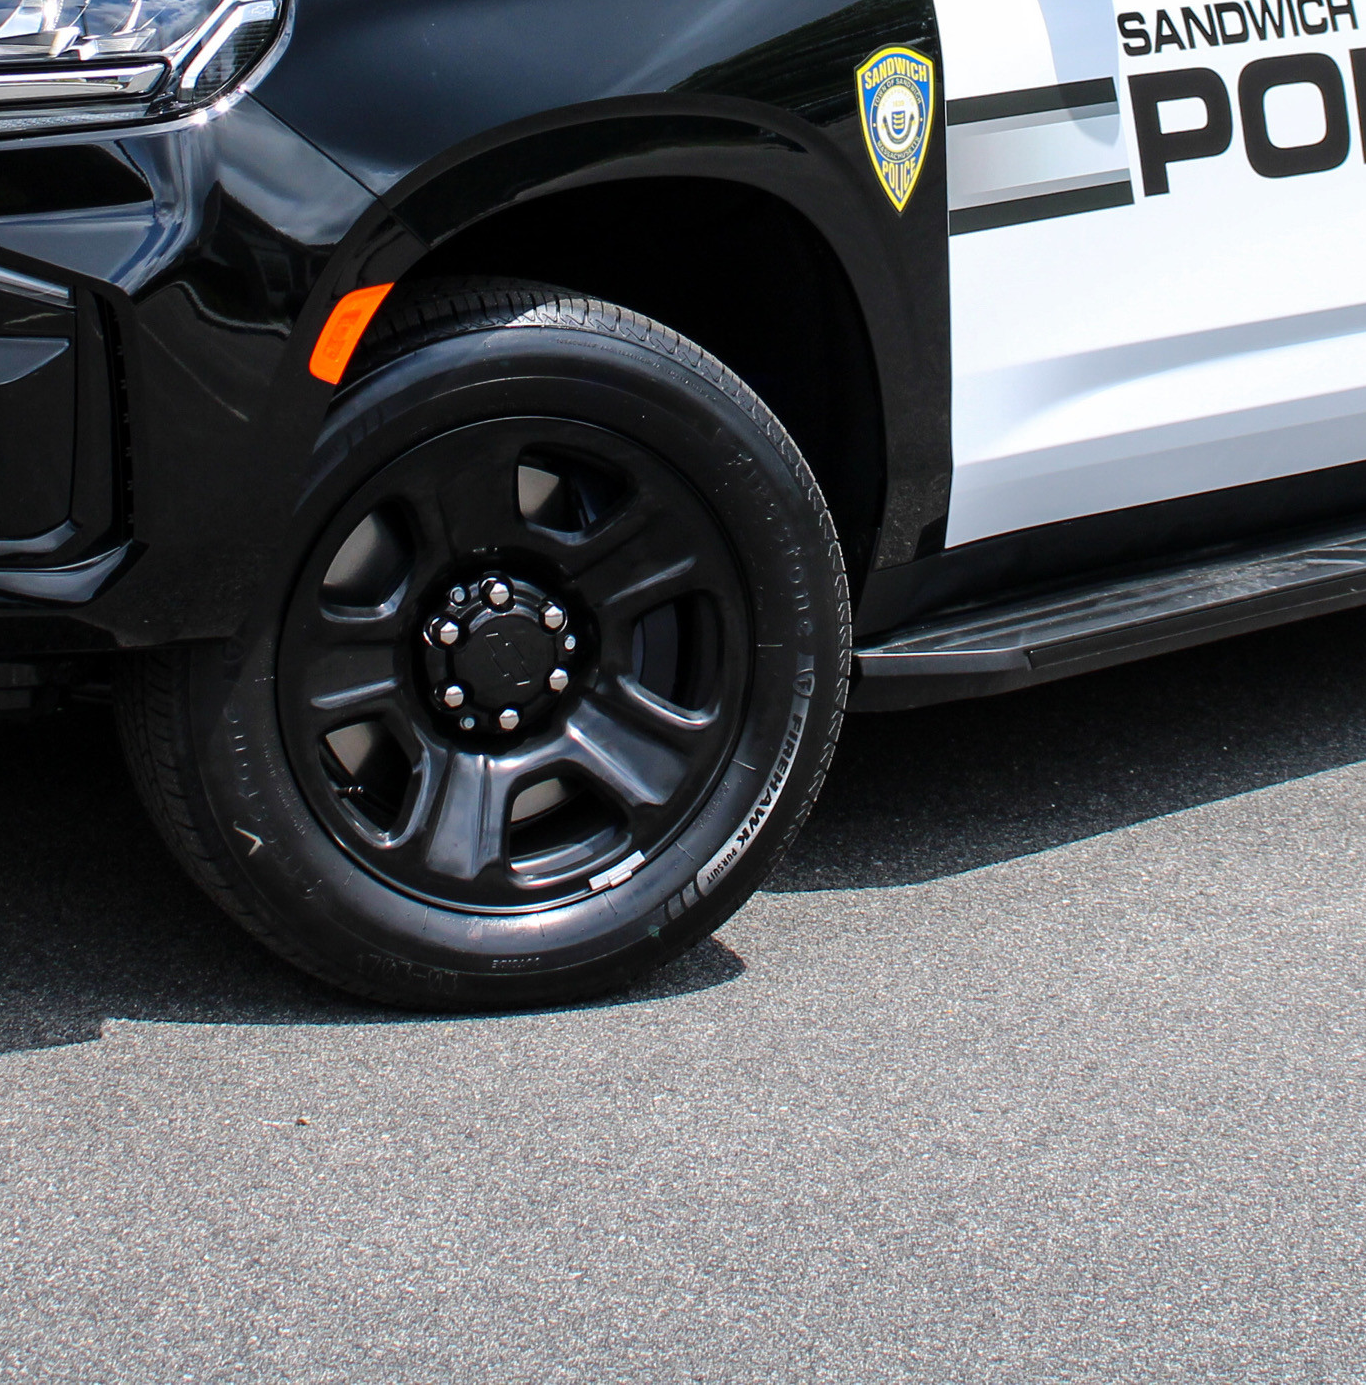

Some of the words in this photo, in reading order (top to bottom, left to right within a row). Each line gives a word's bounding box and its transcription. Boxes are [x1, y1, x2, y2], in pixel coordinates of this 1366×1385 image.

[864, 56, 928, 90] SANDWICH
[882, 156, 917, 199] POLICE
[738, 712, 803, 847] FIREHAWK
[706, 847, 737, 885] PURSUIT
